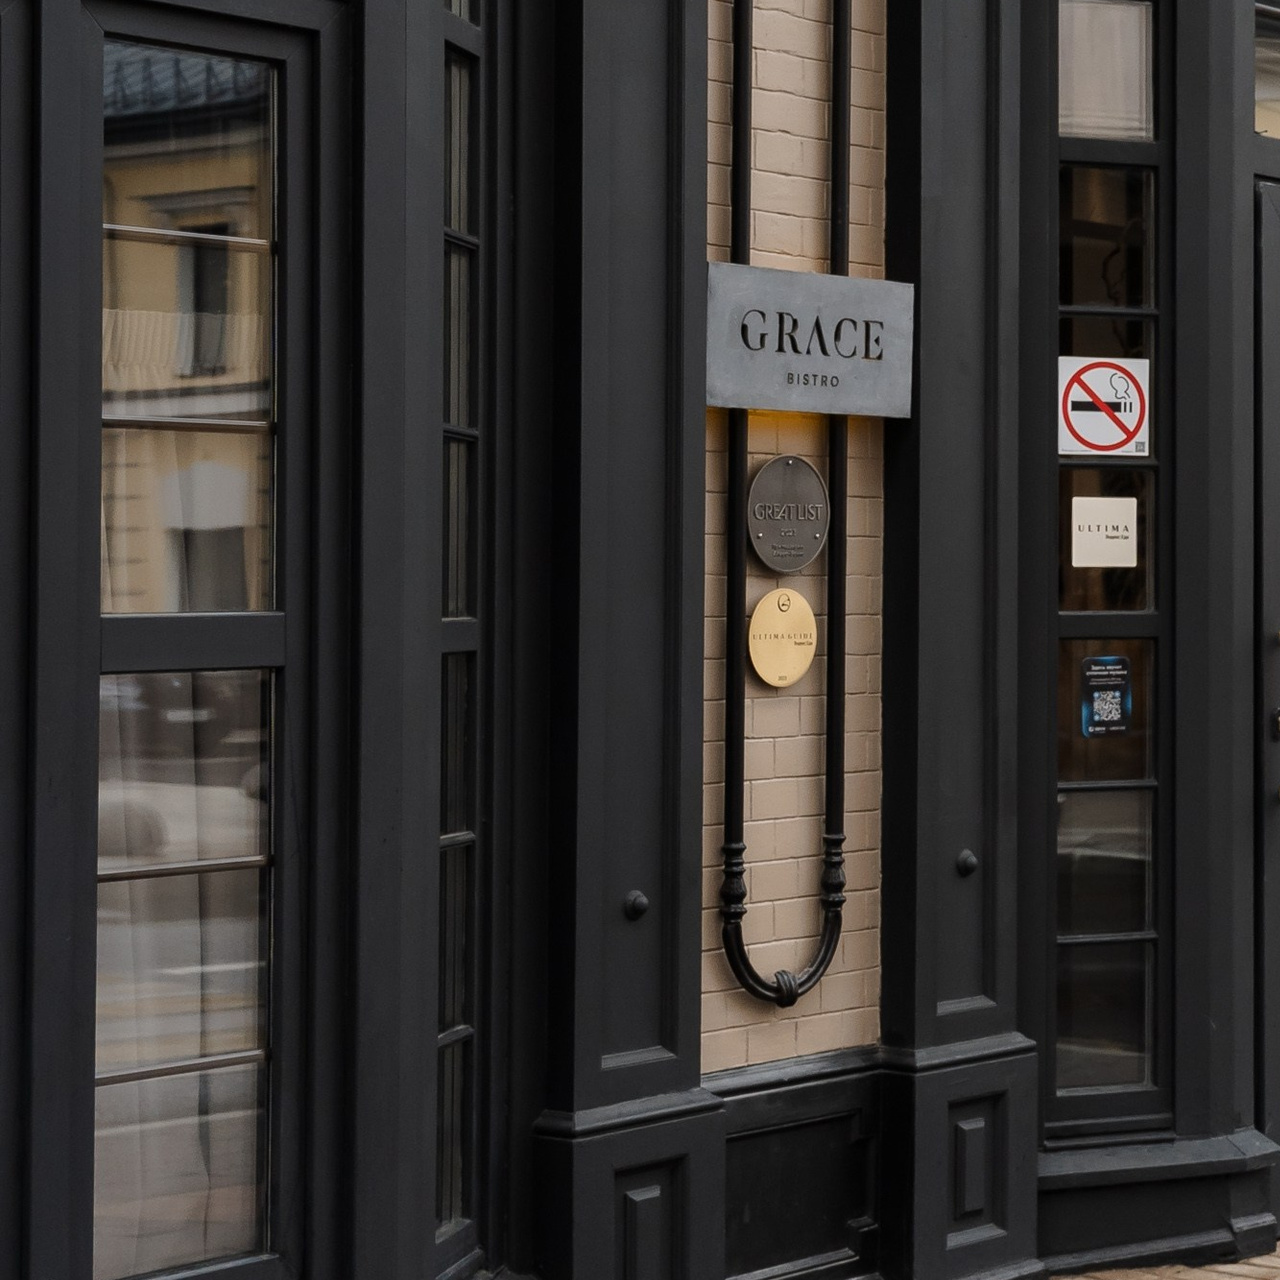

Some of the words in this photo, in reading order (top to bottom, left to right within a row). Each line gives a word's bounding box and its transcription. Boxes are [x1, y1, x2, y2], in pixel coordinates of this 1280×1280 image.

[740, 308, 885, 361] GRACE
[786, 372, 840, 388] BISTRO
[754, 502, 796, 520] GREAT
[797, 503, 824, 520] LIST
[1077, 523, 1130, 533] ULTIMA
[752, 633, 785, 641] ULTIMA
[787, 632, 813, 640] GUIDE
